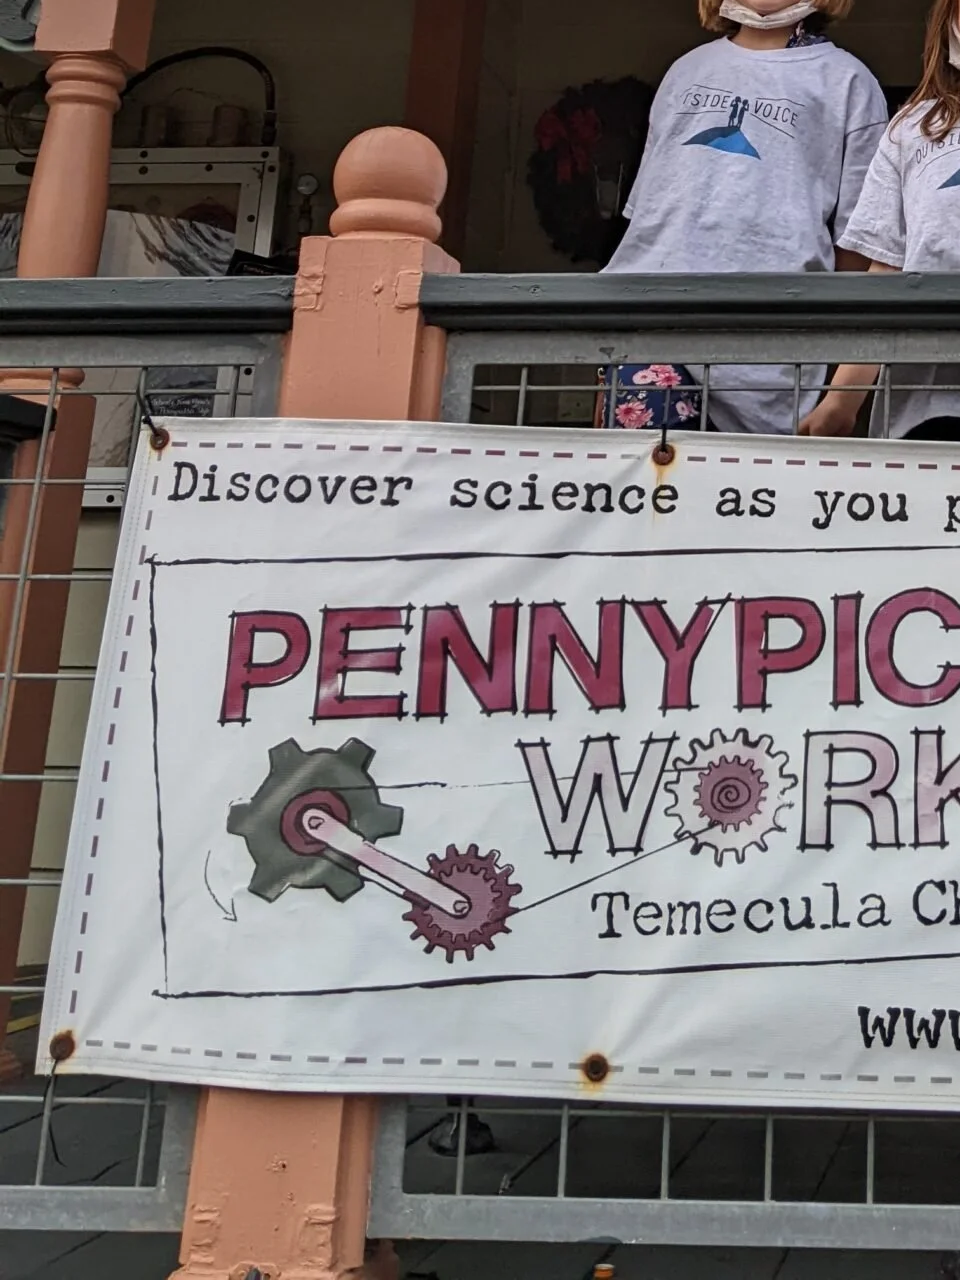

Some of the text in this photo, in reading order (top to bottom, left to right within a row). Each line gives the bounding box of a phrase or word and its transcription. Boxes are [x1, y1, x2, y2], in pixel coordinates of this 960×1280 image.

[754, 100, 798, 127] VOICE
[167, 461, 413, 507] Discover
[449, 472, 679, 514] science
[715, 486, 777, 518] as
[812, 487, 909, 529] you
[591, 883, 891, 939] Temecula
